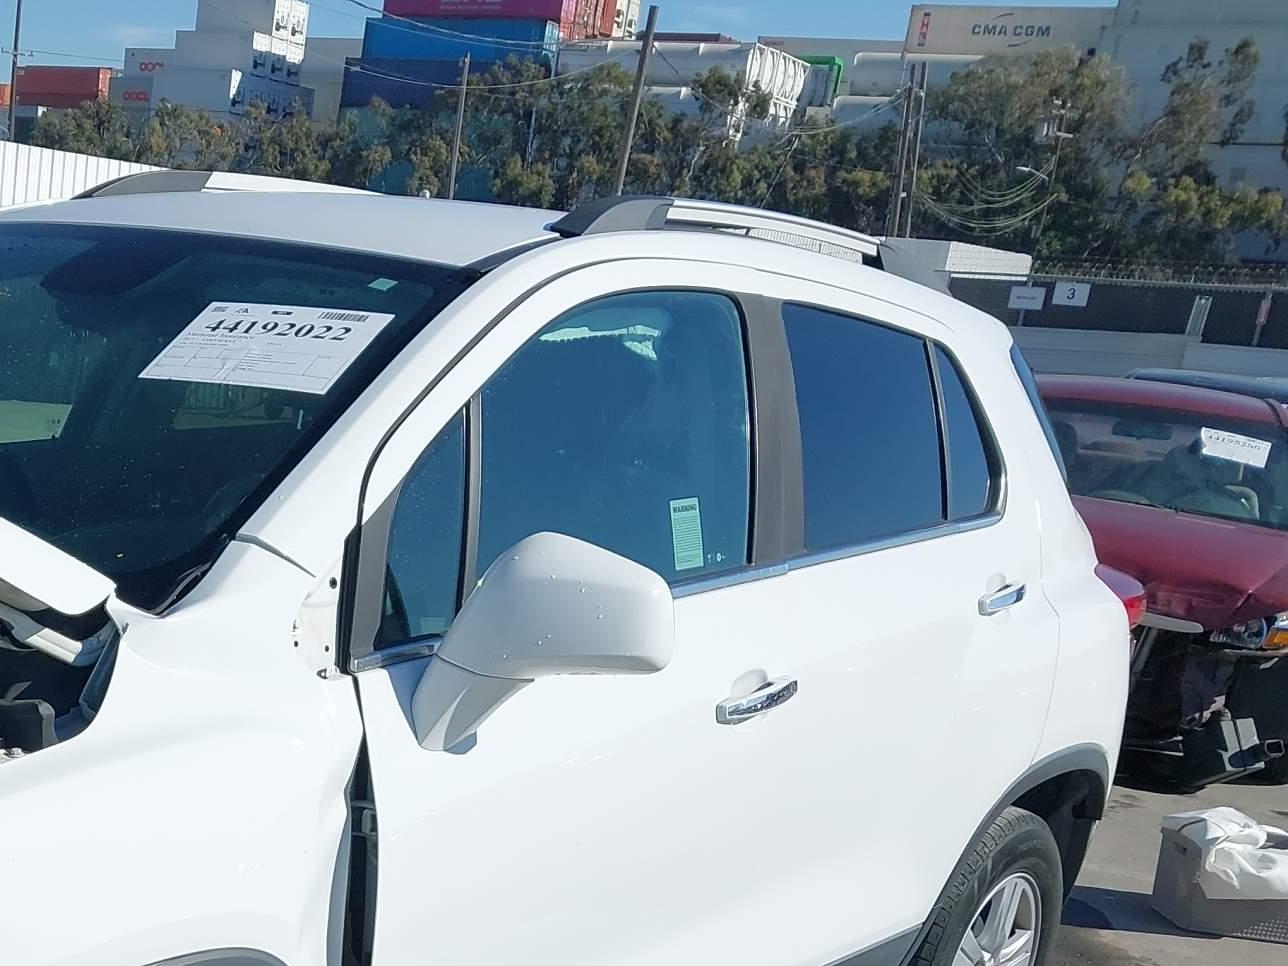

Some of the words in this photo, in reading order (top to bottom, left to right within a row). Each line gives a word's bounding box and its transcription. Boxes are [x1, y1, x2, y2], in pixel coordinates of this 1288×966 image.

[971, 23, 1008, 36] CMA
[1012, 25, 1052, 37] CGM
[1066, 287, 1076, 300] 3
[204, 318, 353, 341] 44192022
